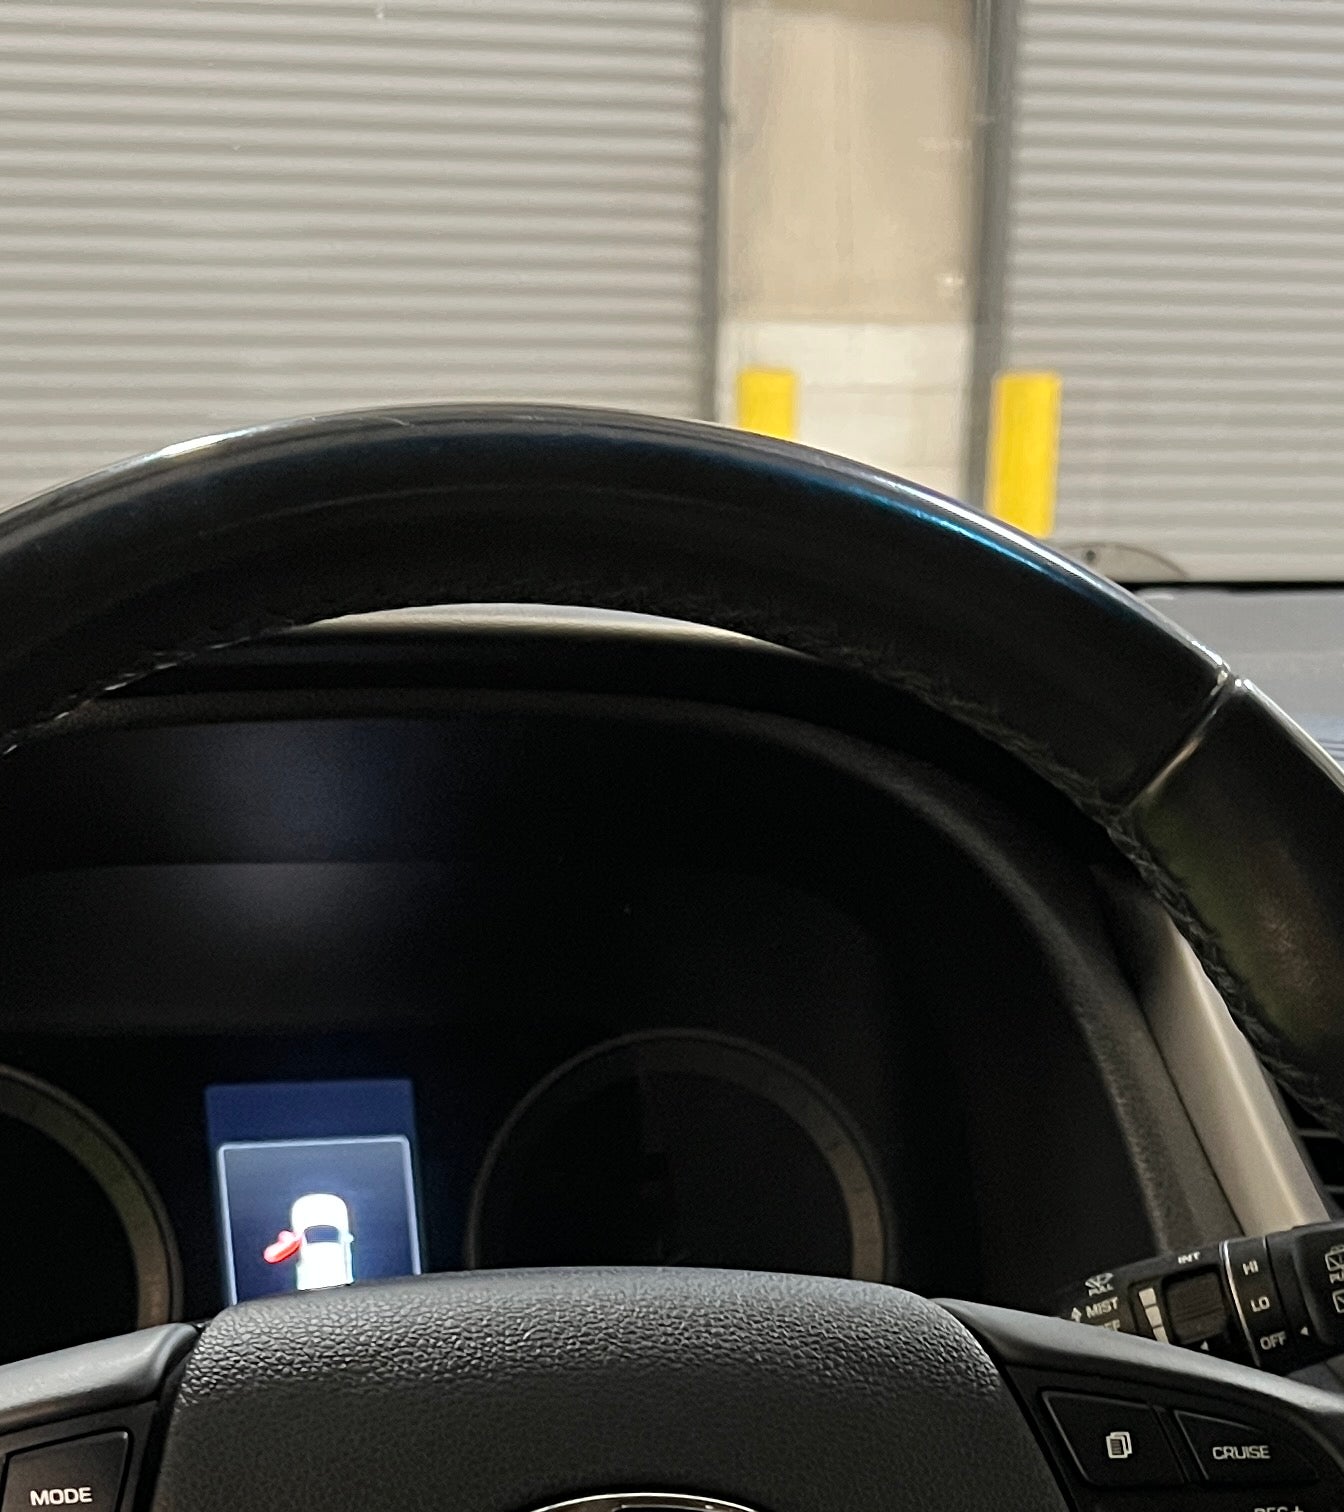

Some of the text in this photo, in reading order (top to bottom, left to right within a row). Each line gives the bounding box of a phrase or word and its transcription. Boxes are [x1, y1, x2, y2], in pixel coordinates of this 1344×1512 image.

[1178, 1251, 1201, 1265] INT
[1242, 1260, 1260, 1276] HI
[1084, 1296, 1119, 1319] MIST
[1249, 1295, 1271, 1313] LO
[1259, 1331, 1287, 1351] OFF
[1211, 1444, 1271, 1461] CRUISE
[29, 1486, 94, 1507] MODE
